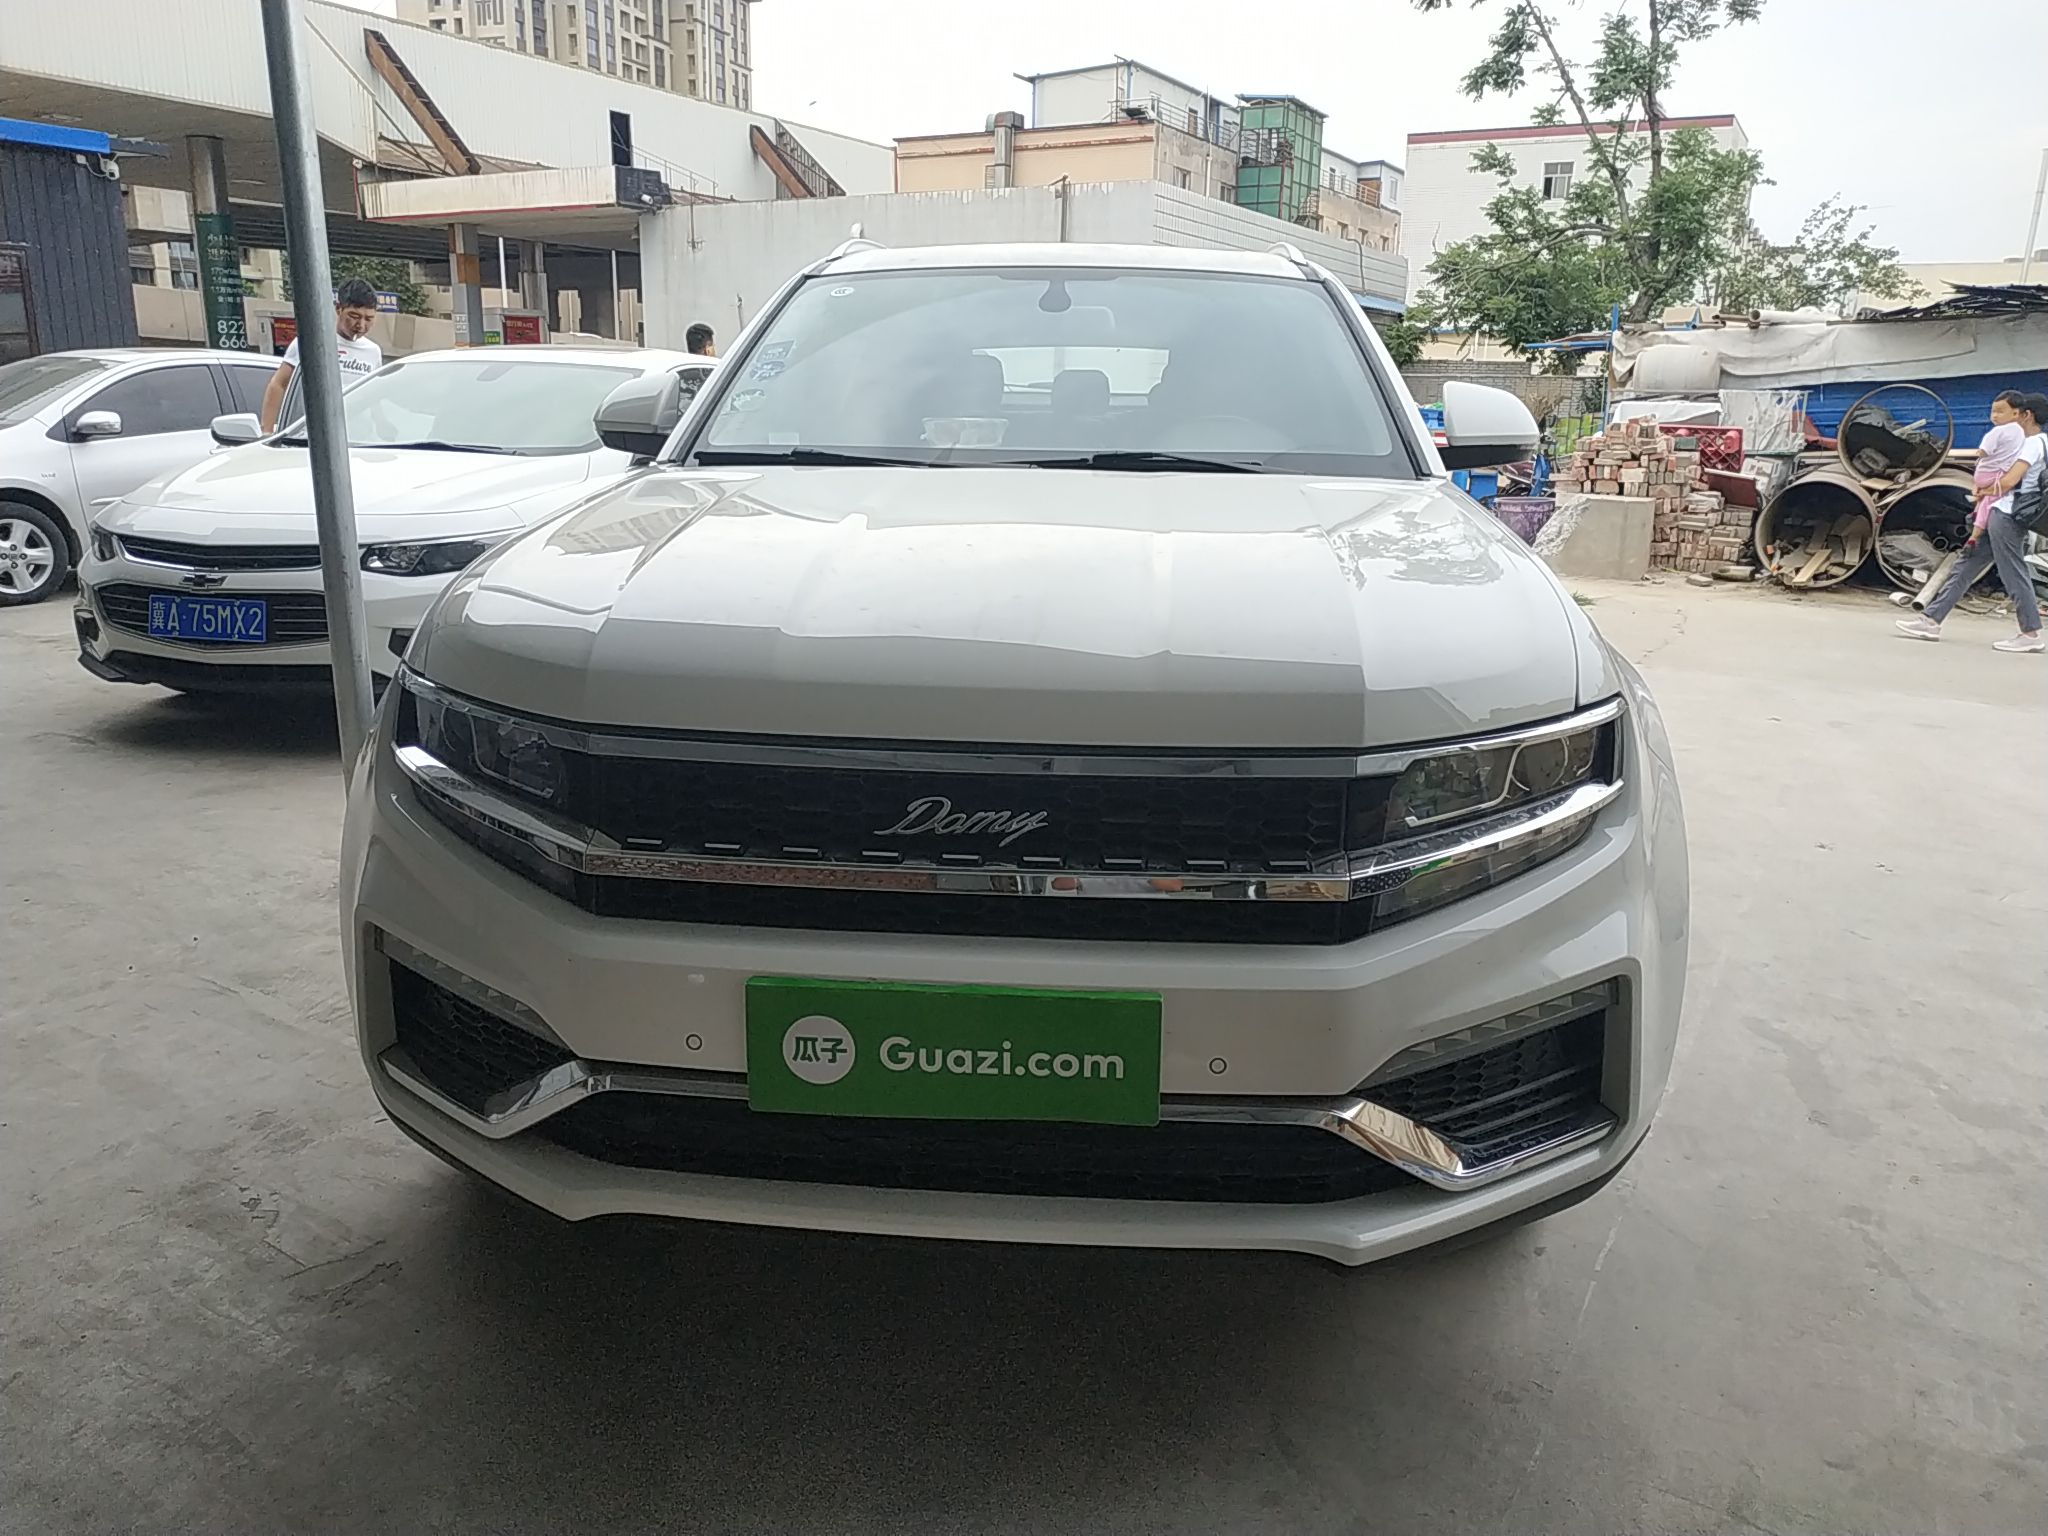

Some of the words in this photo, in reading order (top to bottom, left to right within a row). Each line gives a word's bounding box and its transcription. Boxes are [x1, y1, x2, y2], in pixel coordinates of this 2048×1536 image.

[217, 320, 245, 334] 822
[219, 335, 247, 349] 666
[792, 1036, 848, 1064] 瓜子
[879, 1036, 1125, 1079] Guazi.com
